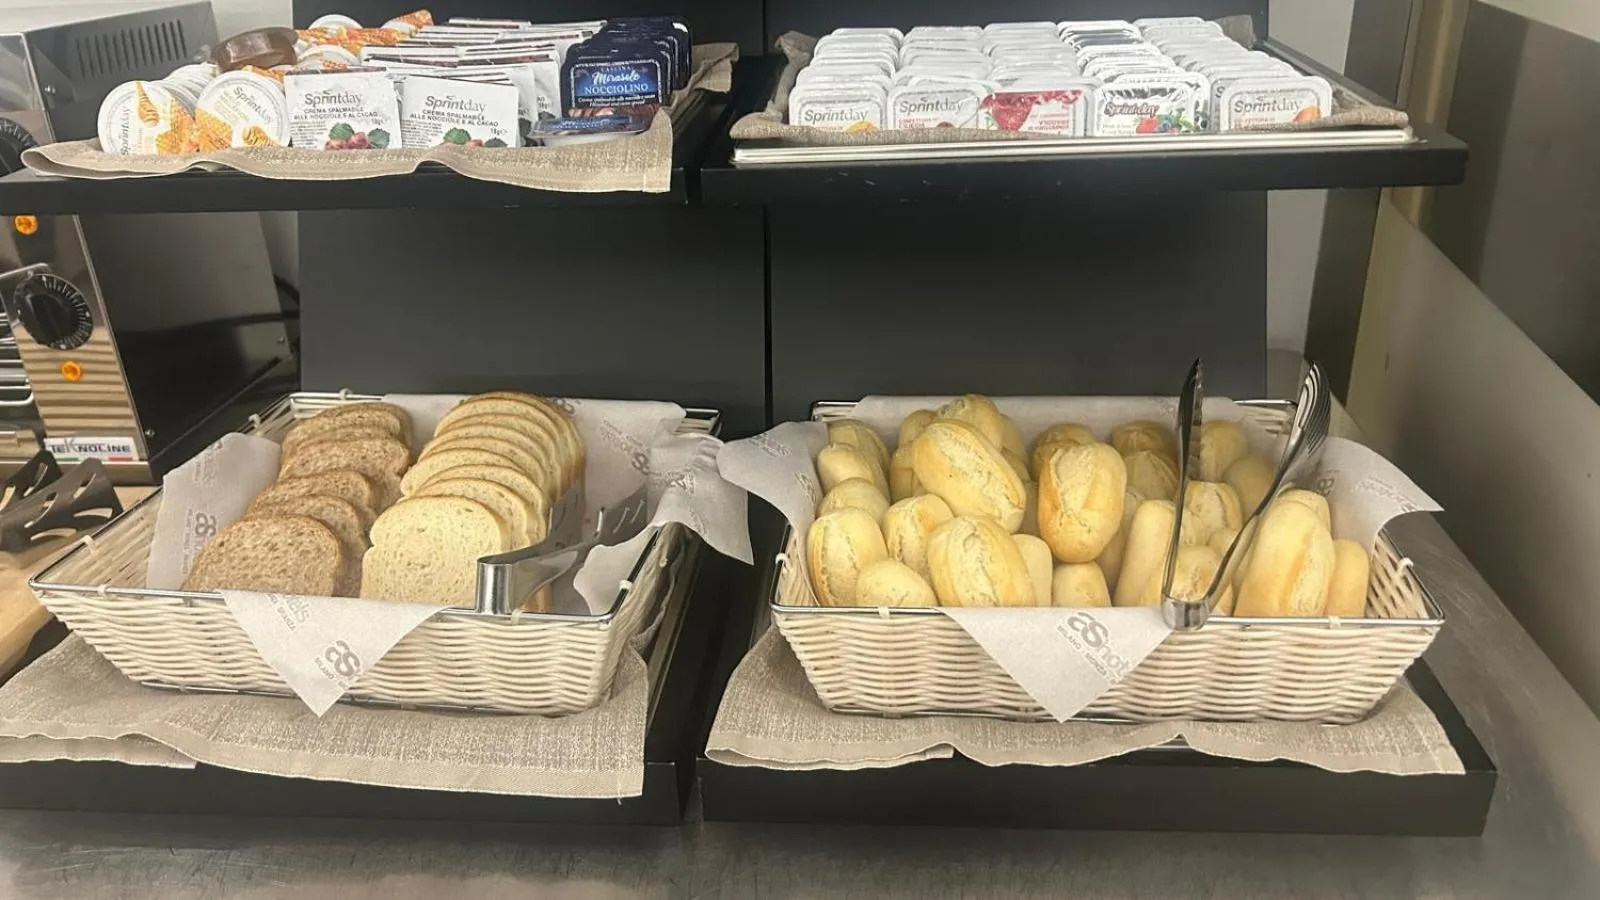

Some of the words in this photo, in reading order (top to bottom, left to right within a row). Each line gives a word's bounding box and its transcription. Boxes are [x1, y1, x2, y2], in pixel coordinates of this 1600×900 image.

[584, 82, 649, 95] NOCCIOLINO
[304, 91, 363, 107] Sprintday
[425, 95, 487, 112] Sprintday
[899, 97, 963, 115] Sprintday
[1233, 98, 1300, 114] Sprintday
[422, 109, 446, 117] CREMA
[446, 110, 485, 121] SPALMABILE
[804, 108, 869, 125] Sprintday
[1057, 624, 1081, 651] MILANO
